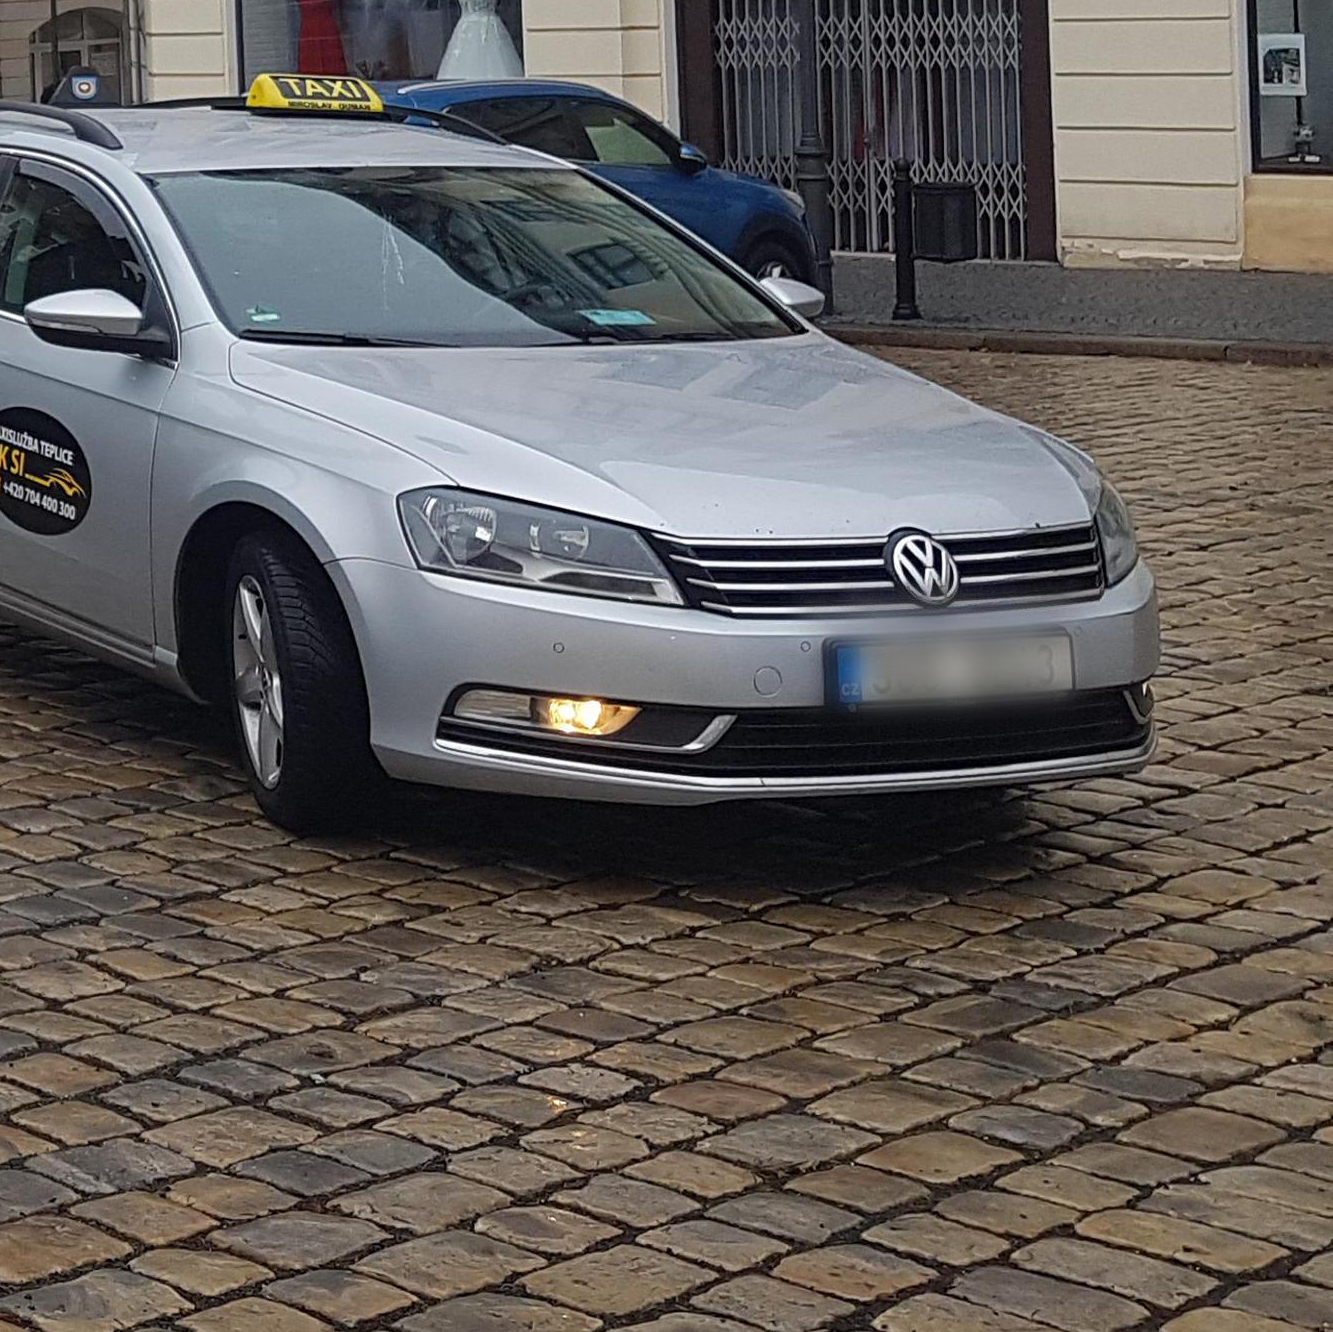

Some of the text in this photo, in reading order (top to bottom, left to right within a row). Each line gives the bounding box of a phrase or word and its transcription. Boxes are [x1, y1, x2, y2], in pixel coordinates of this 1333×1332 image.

[278, 77, 362, 99] TAXI
[40, 440, 74, 466] TEPLICE
[3, 481, 76, 520] +420 704 400 300
[841, 683, 860, 696] CZ
